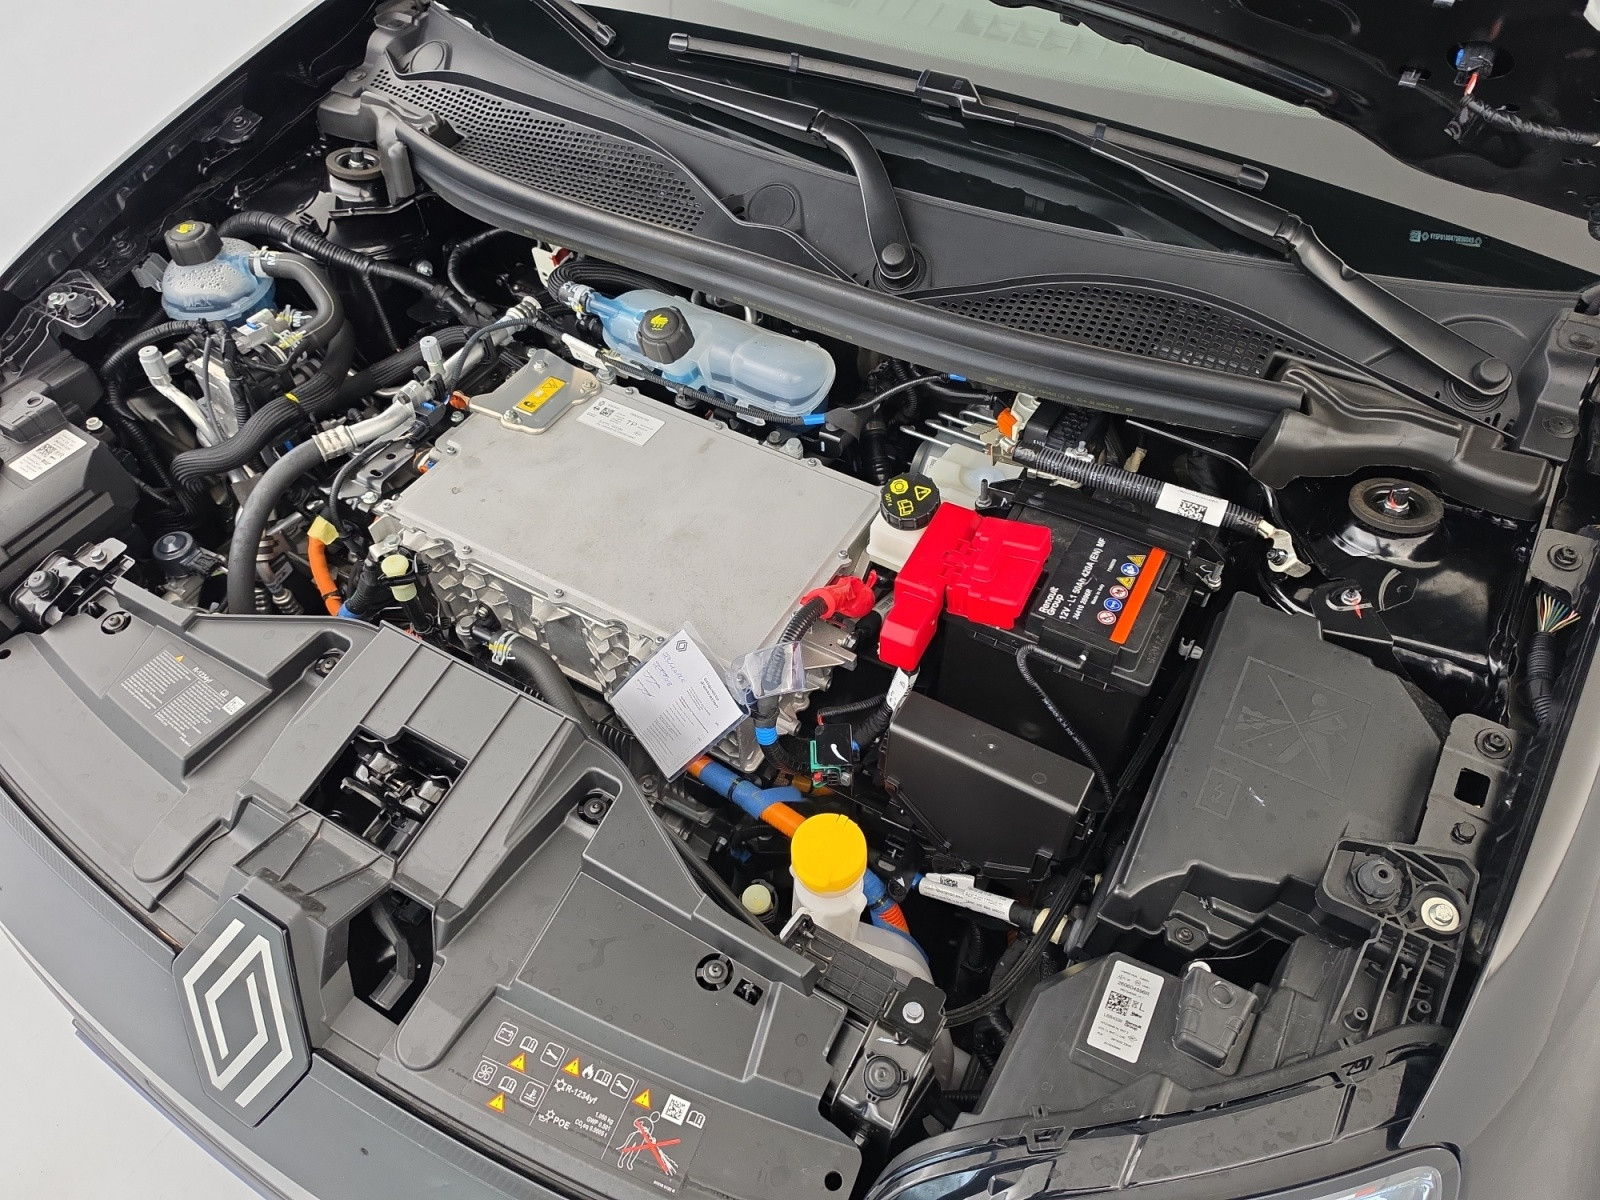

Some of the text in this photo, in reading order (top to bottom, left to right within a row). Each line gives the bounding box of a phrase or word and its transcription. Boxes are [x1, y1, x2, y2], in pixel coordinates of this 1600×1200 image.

[1059, 606, 1071, 620] 12V
[1067, 594, 1077, 604] L1
[1072, 577, 1087, 595] 50Ah
[1081, 561, 1095, 578] 420A
[1089, 547, 1103, 563] (EN)
[1096, 537, 1106, 548] MF
[1039, 586, 1059, 613] Renault
[1047, 594, 1065, 616] Group
[564, 1083, 598, 1105] R-1234yf
[552, 1116, 571, 1130] POE
